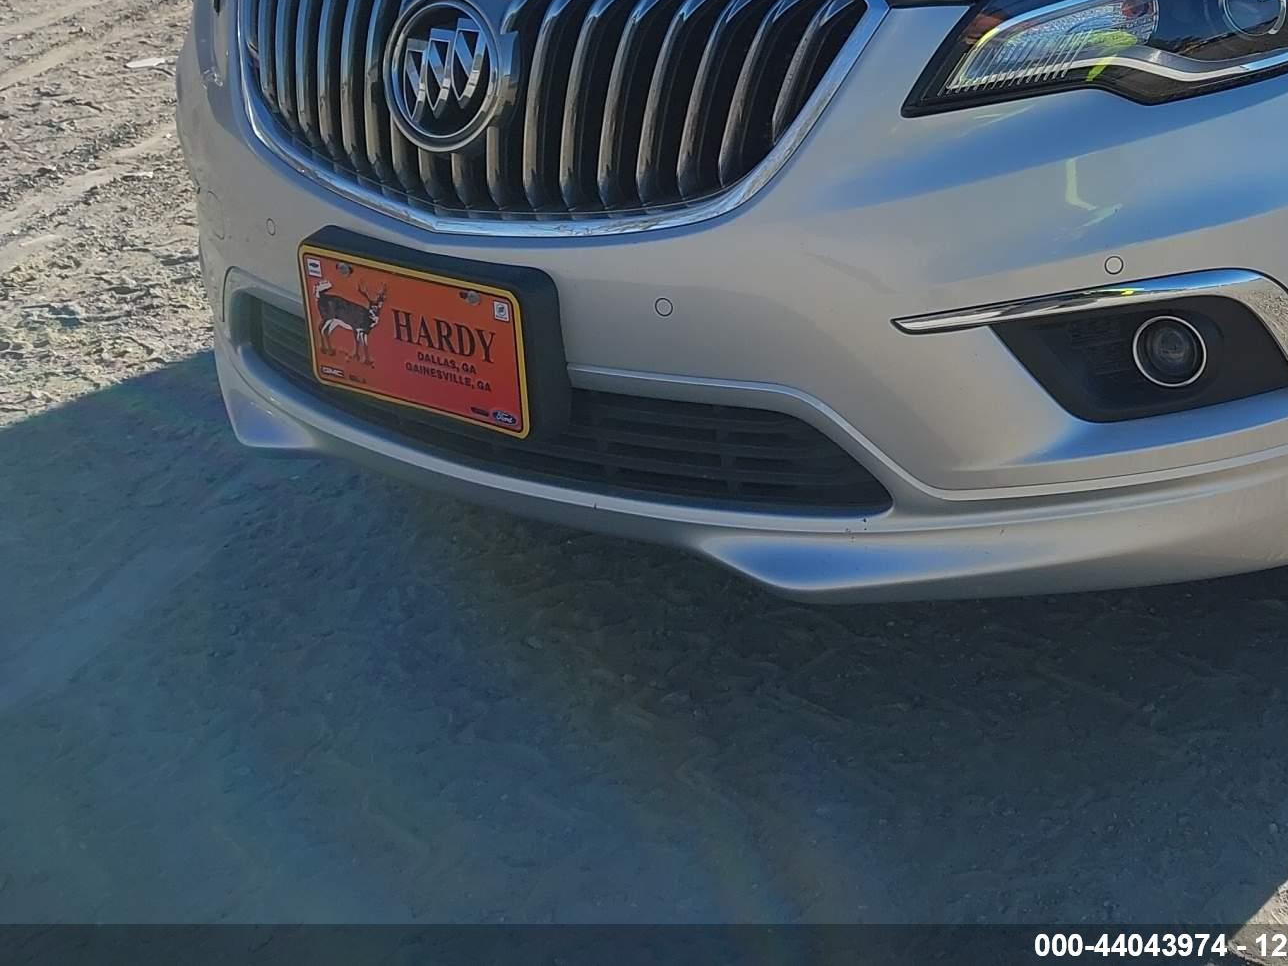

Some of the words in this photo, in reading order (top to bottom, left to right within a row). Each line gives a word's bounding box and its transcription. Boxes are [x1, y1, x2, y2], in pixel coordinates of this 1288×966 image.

[392, 309, 496, 363] HARDY
[321, 366, 345, 377] GMC
[417, 352, 459, 372] DALLAS,
[461, 362, 477, 374] GA
[405, 361, 474, 389] GAINESVILLE,
[476, 380, 492, 391] GA
[494, 411, 514, 424] Ford
